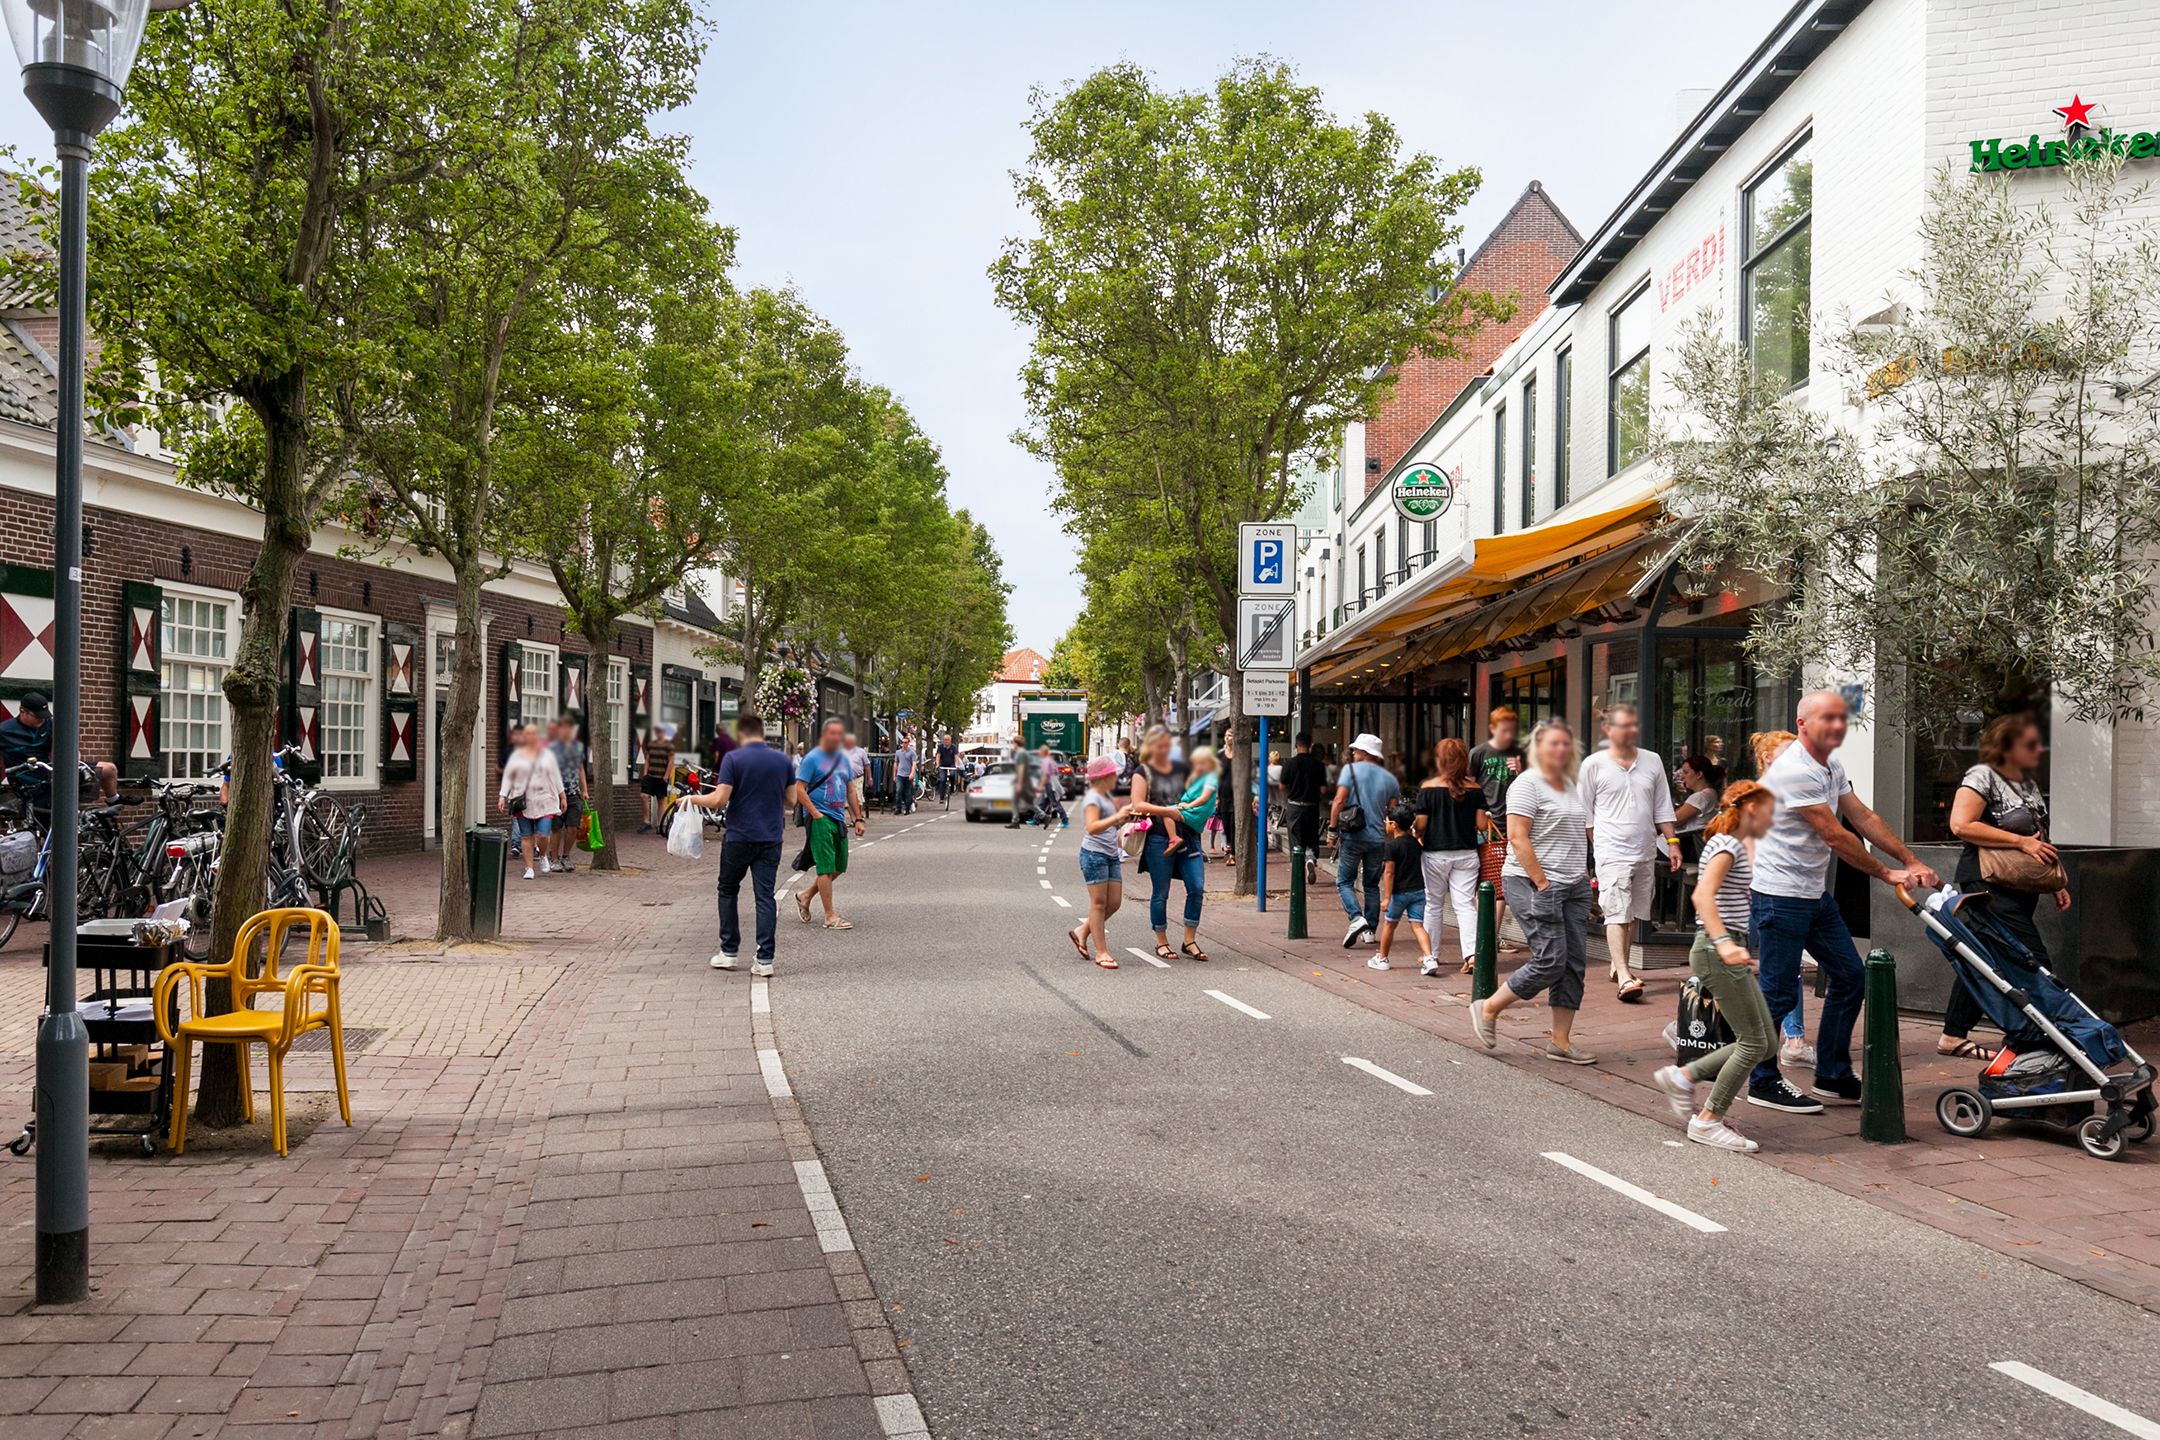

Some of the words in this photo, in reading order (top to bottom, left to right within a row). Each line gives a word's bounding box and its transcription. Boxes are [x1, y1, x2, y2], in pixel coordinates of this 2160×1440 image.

[1969, 127, 2160, 173] Heineke
[1658, 223, 1725, 315] VERDI
[1397, 486, 1449, 498] Heineken
[1260, 542, 1278, 566] P
[1254, 603, 1281, 611] ZONE
